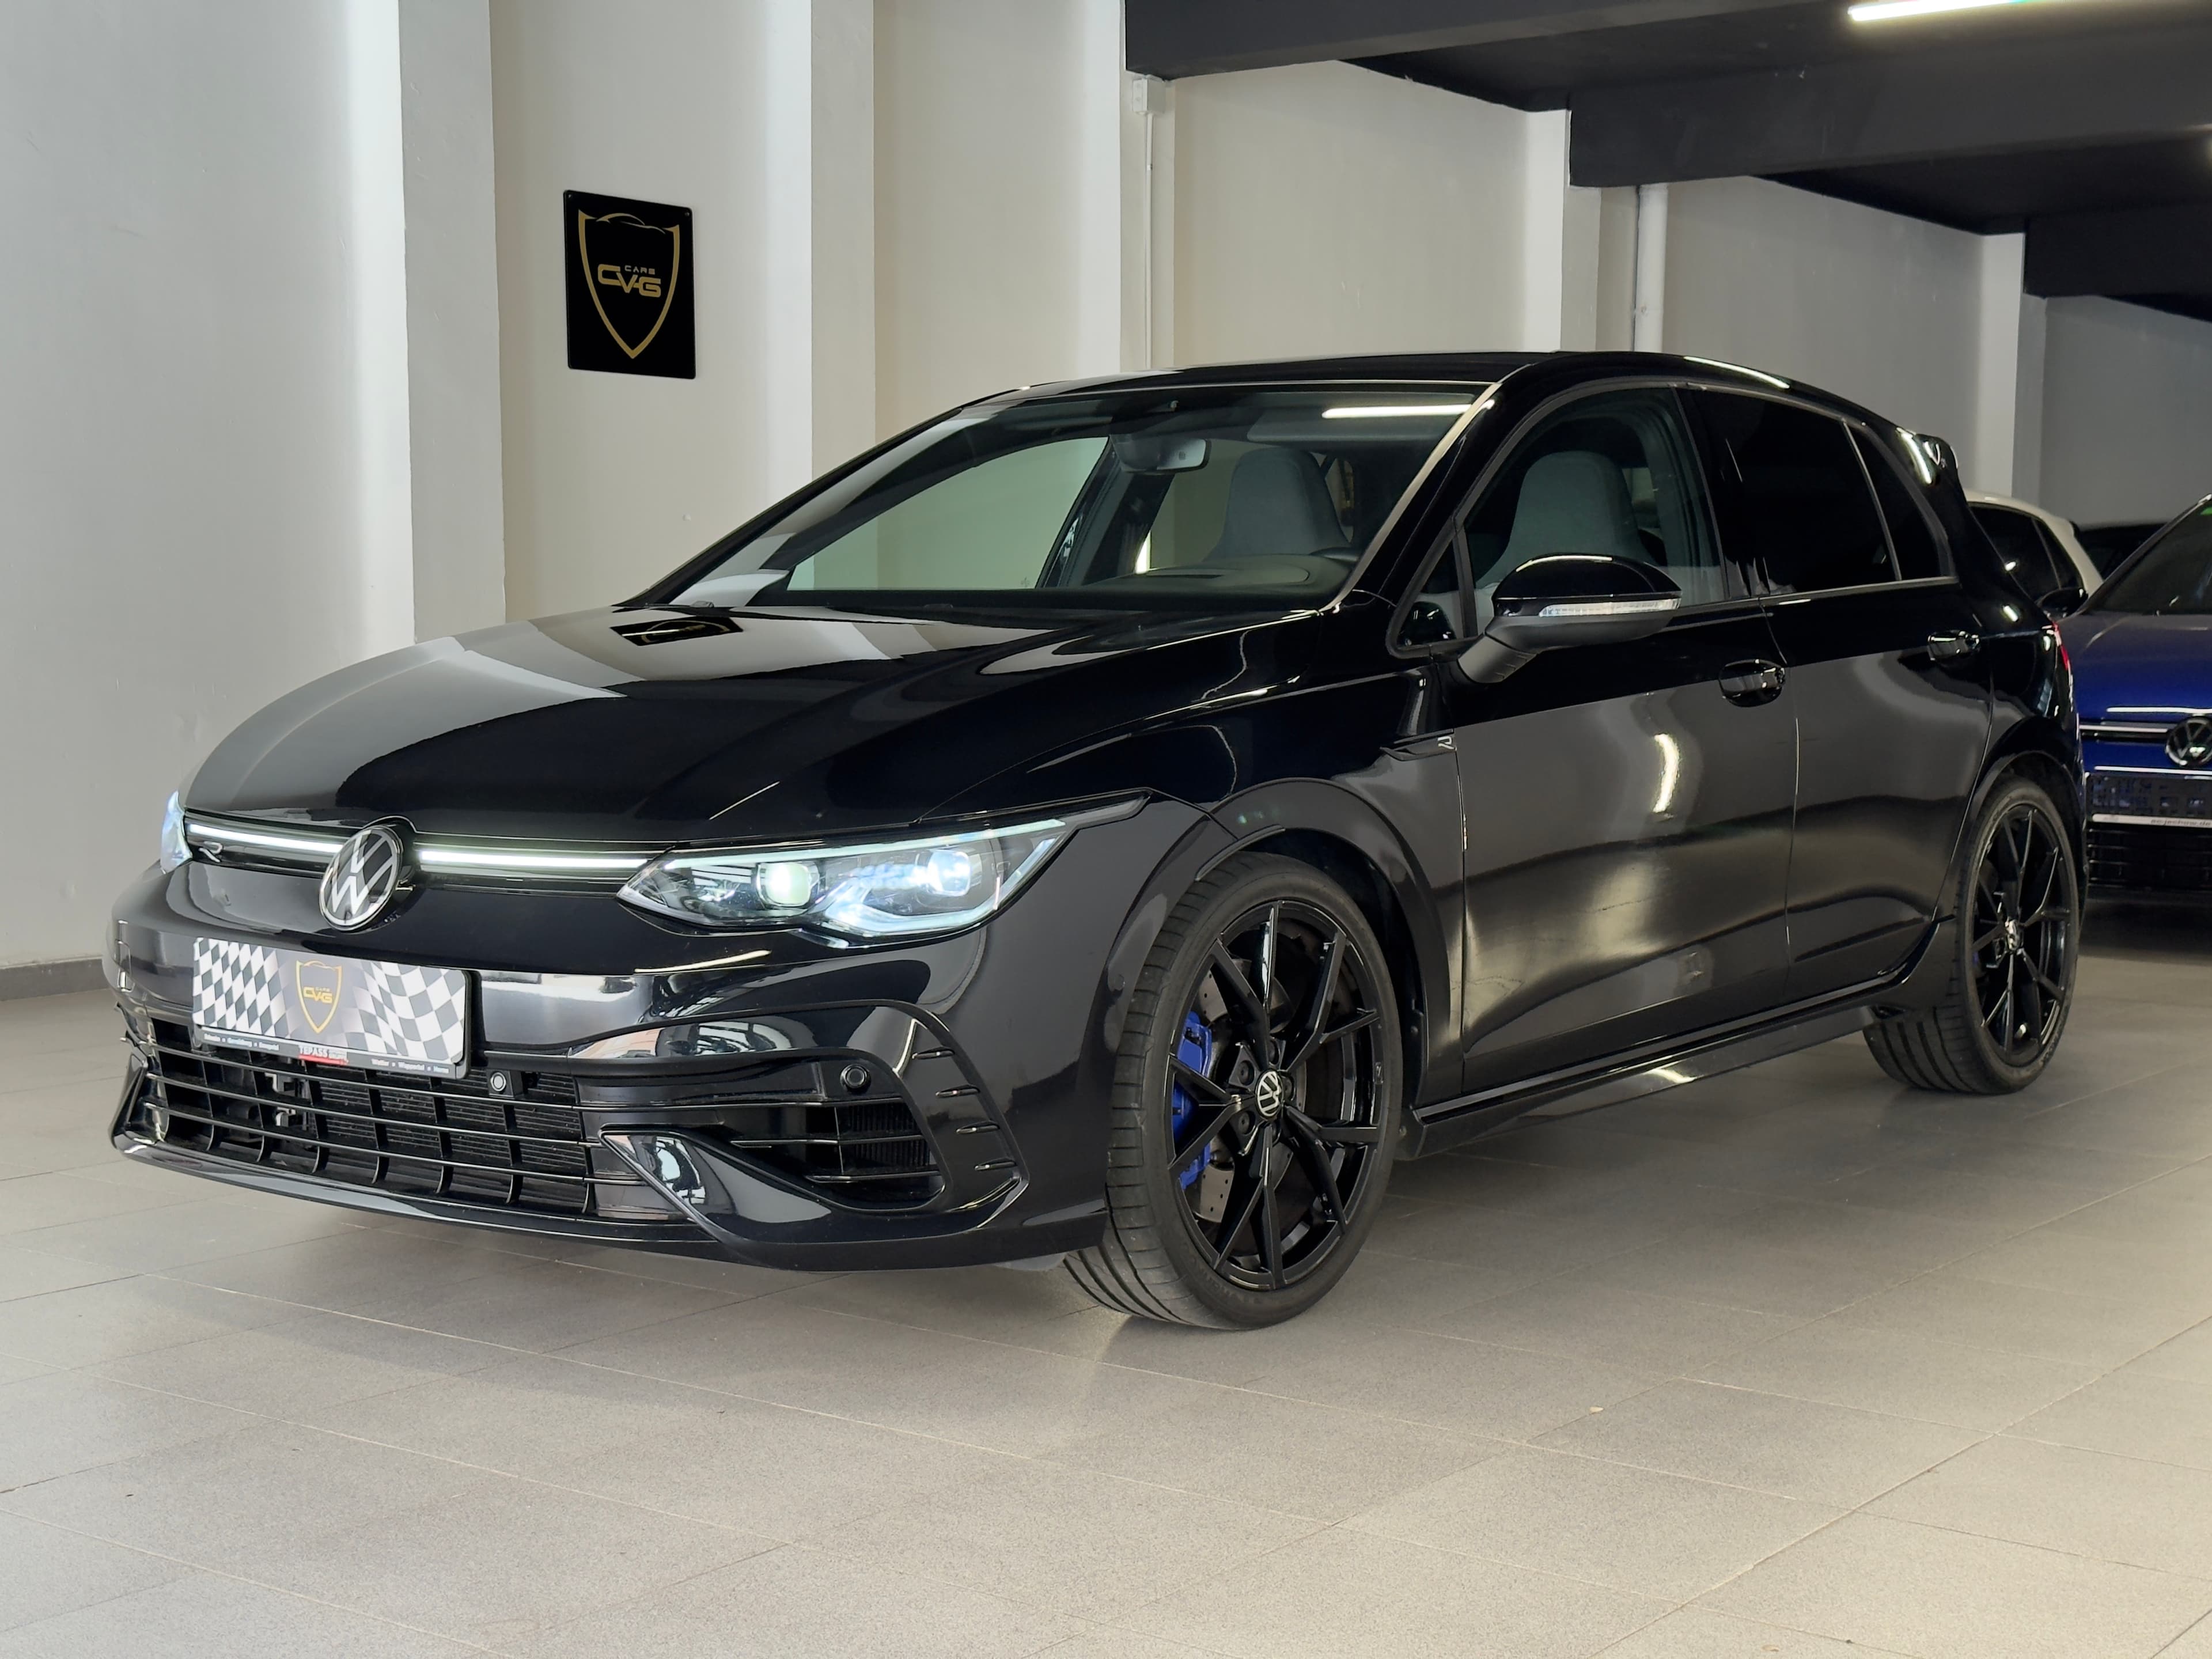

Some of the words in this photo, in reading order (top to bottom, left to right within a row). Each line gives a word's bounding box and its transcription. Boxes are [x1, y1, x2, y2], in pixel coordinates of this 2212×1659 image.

[624, 265, 655, 275] CARS
[597, 264, 661, 297] CVG
[1438, 736, 1455, 749] R
[198, 841, 223, 862] R
[304, 986, 332, 1004] CVG
